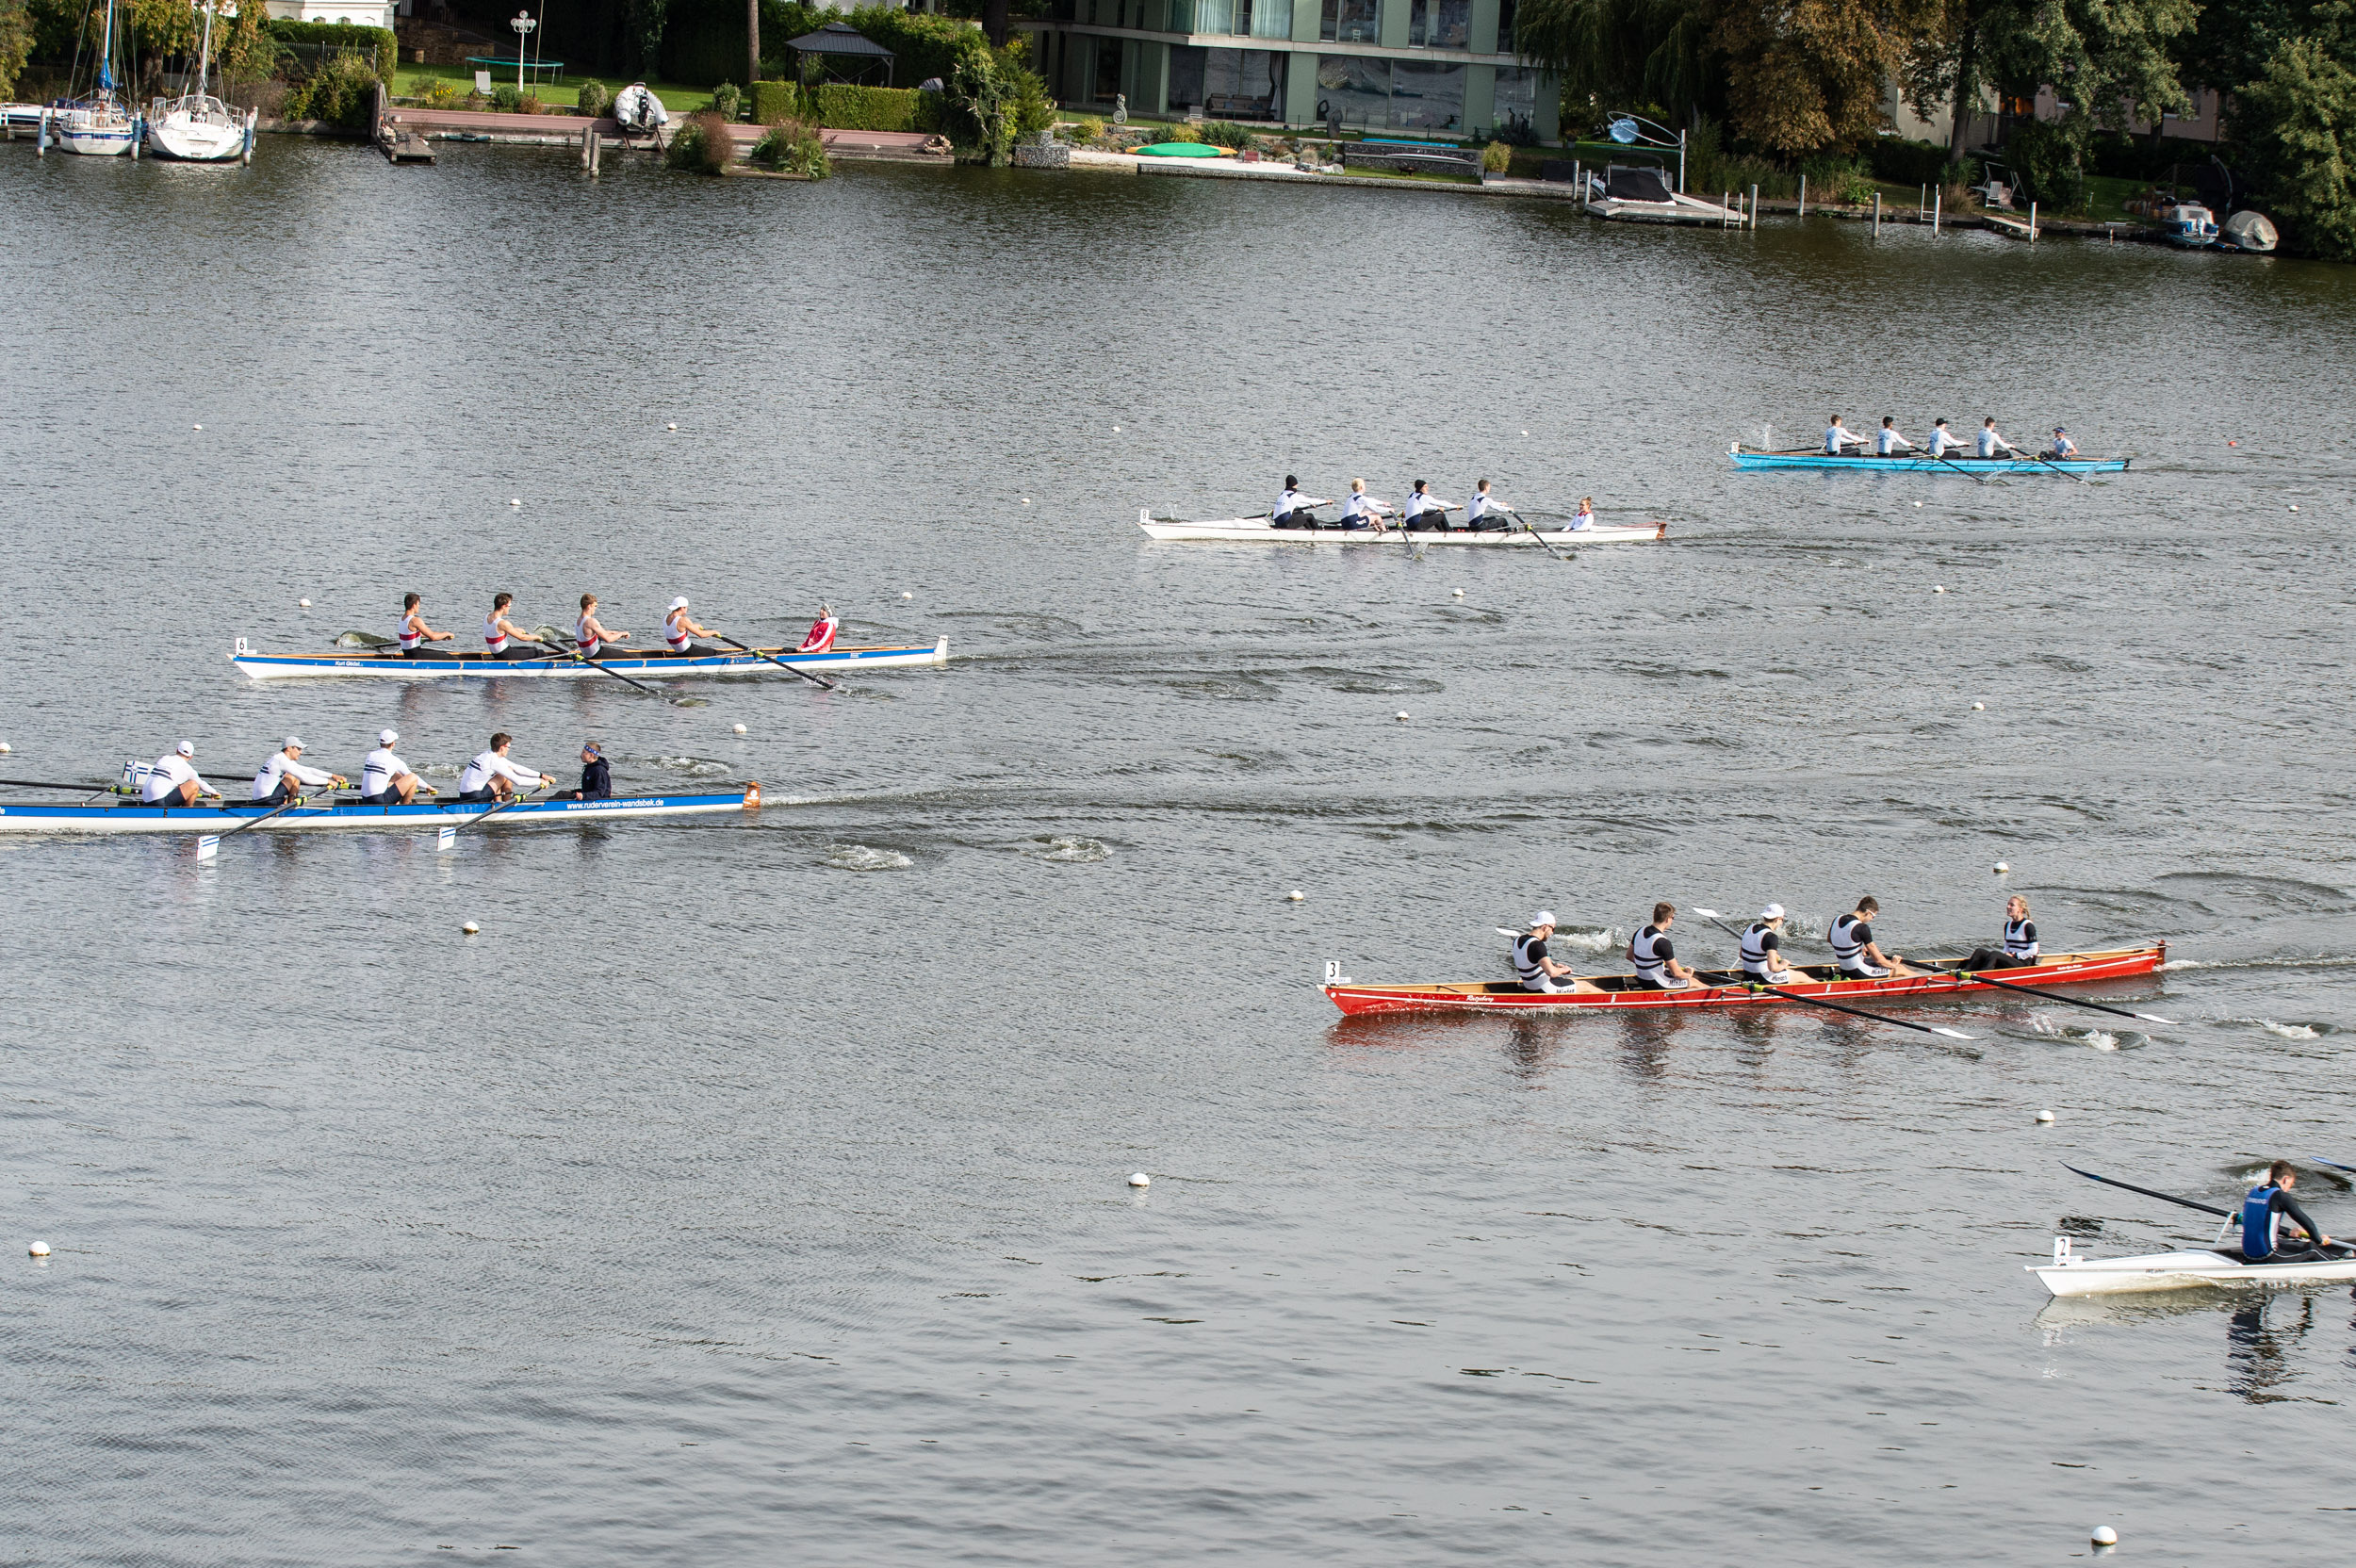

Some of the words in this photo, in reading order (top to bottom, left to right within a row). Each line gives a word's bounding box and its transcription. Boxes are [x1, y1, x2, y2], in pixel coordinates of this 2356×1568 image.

[239, 639, 245, 650] 6
[566, 798, 663, 810] www.ruderverein-wandsbek.de
[1330, 962, 1335, 977] 3
[2060, 1238, 2066, 1256] 2
